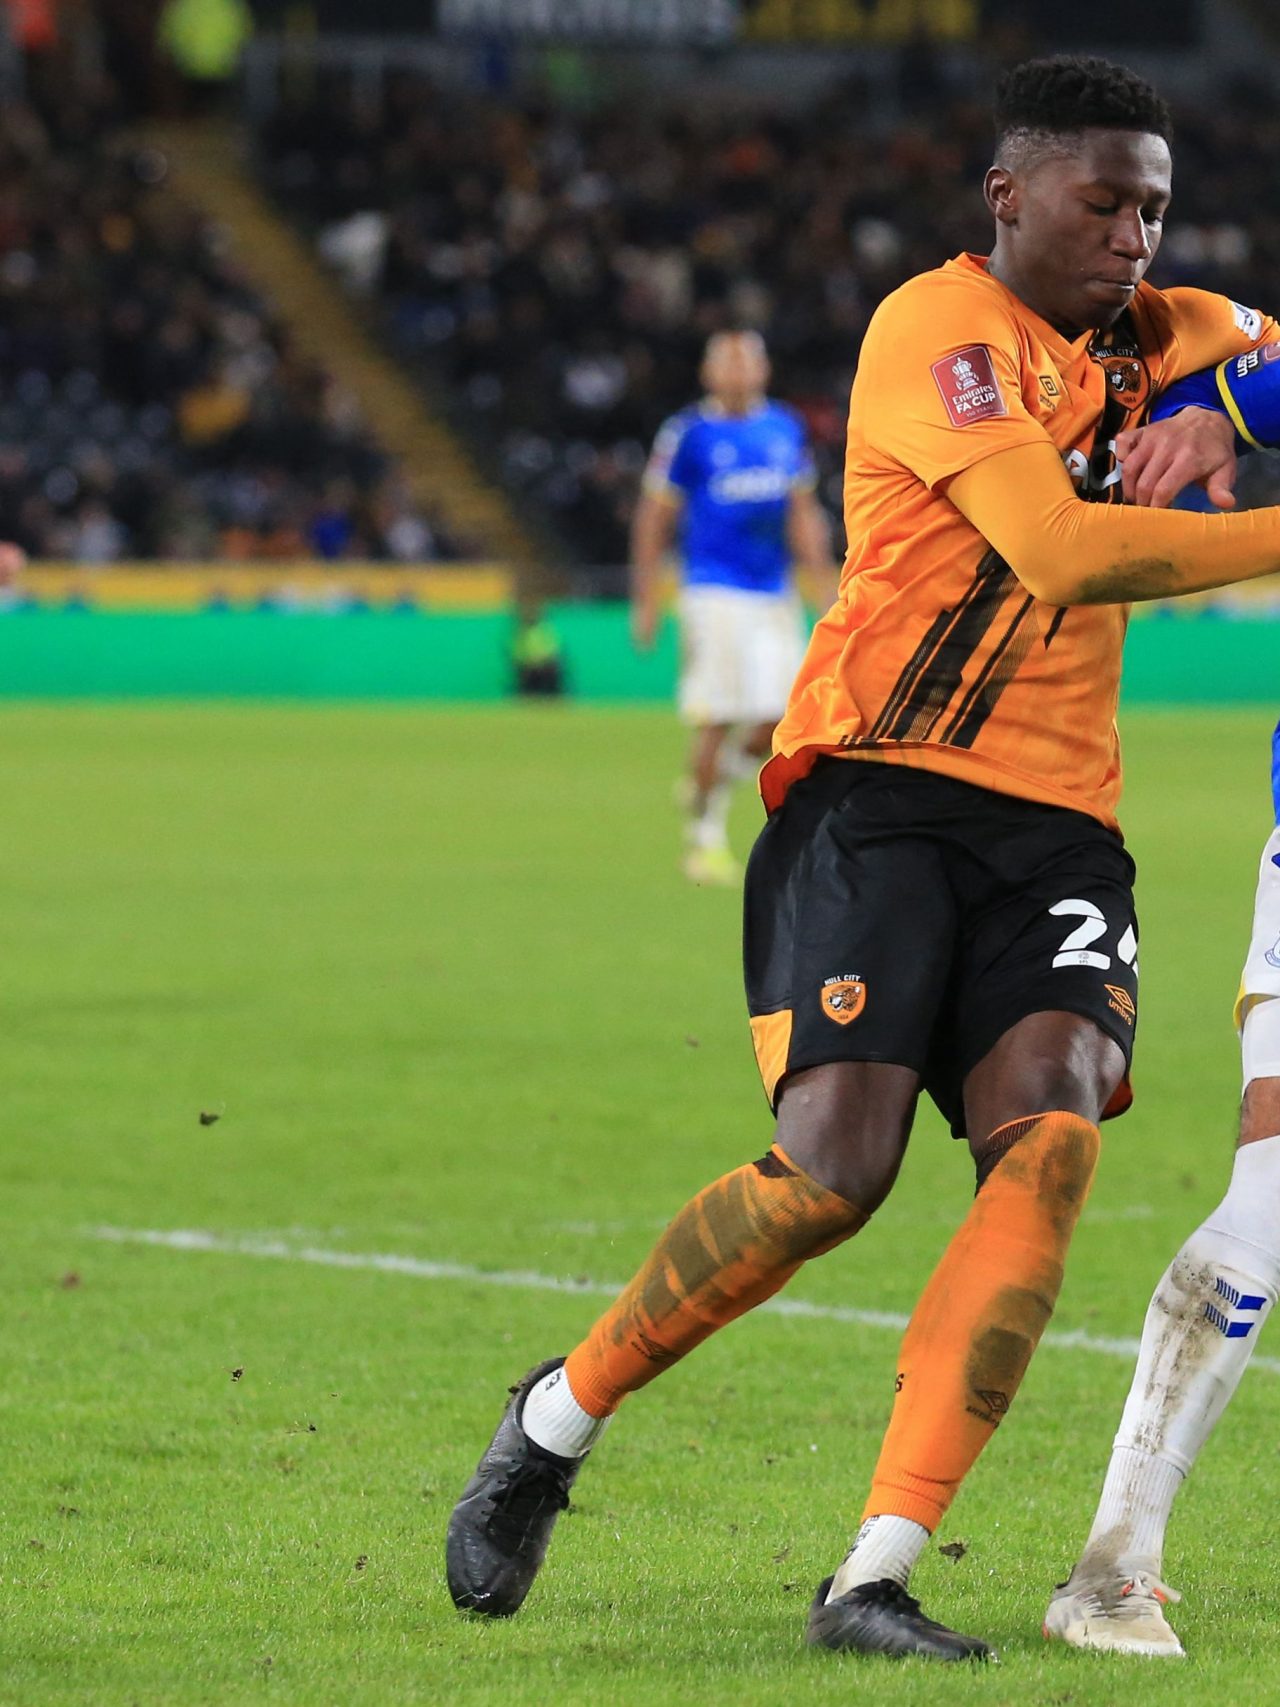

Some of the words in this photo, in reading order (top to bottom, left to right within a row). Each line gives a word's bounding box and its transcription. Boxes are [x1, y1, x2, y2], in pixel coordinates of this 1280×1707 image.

[1095, 348, 1115, 358] HULL
[1117, 348, 1134, 357] CITY
[951, 384, 994, 406] Emirates
[956, 401, 972, 415] FA
[971, 392, 996, 407] CUP
[823, 975, 842, 986] HULL
[843, 974, 861, 982] CITY
